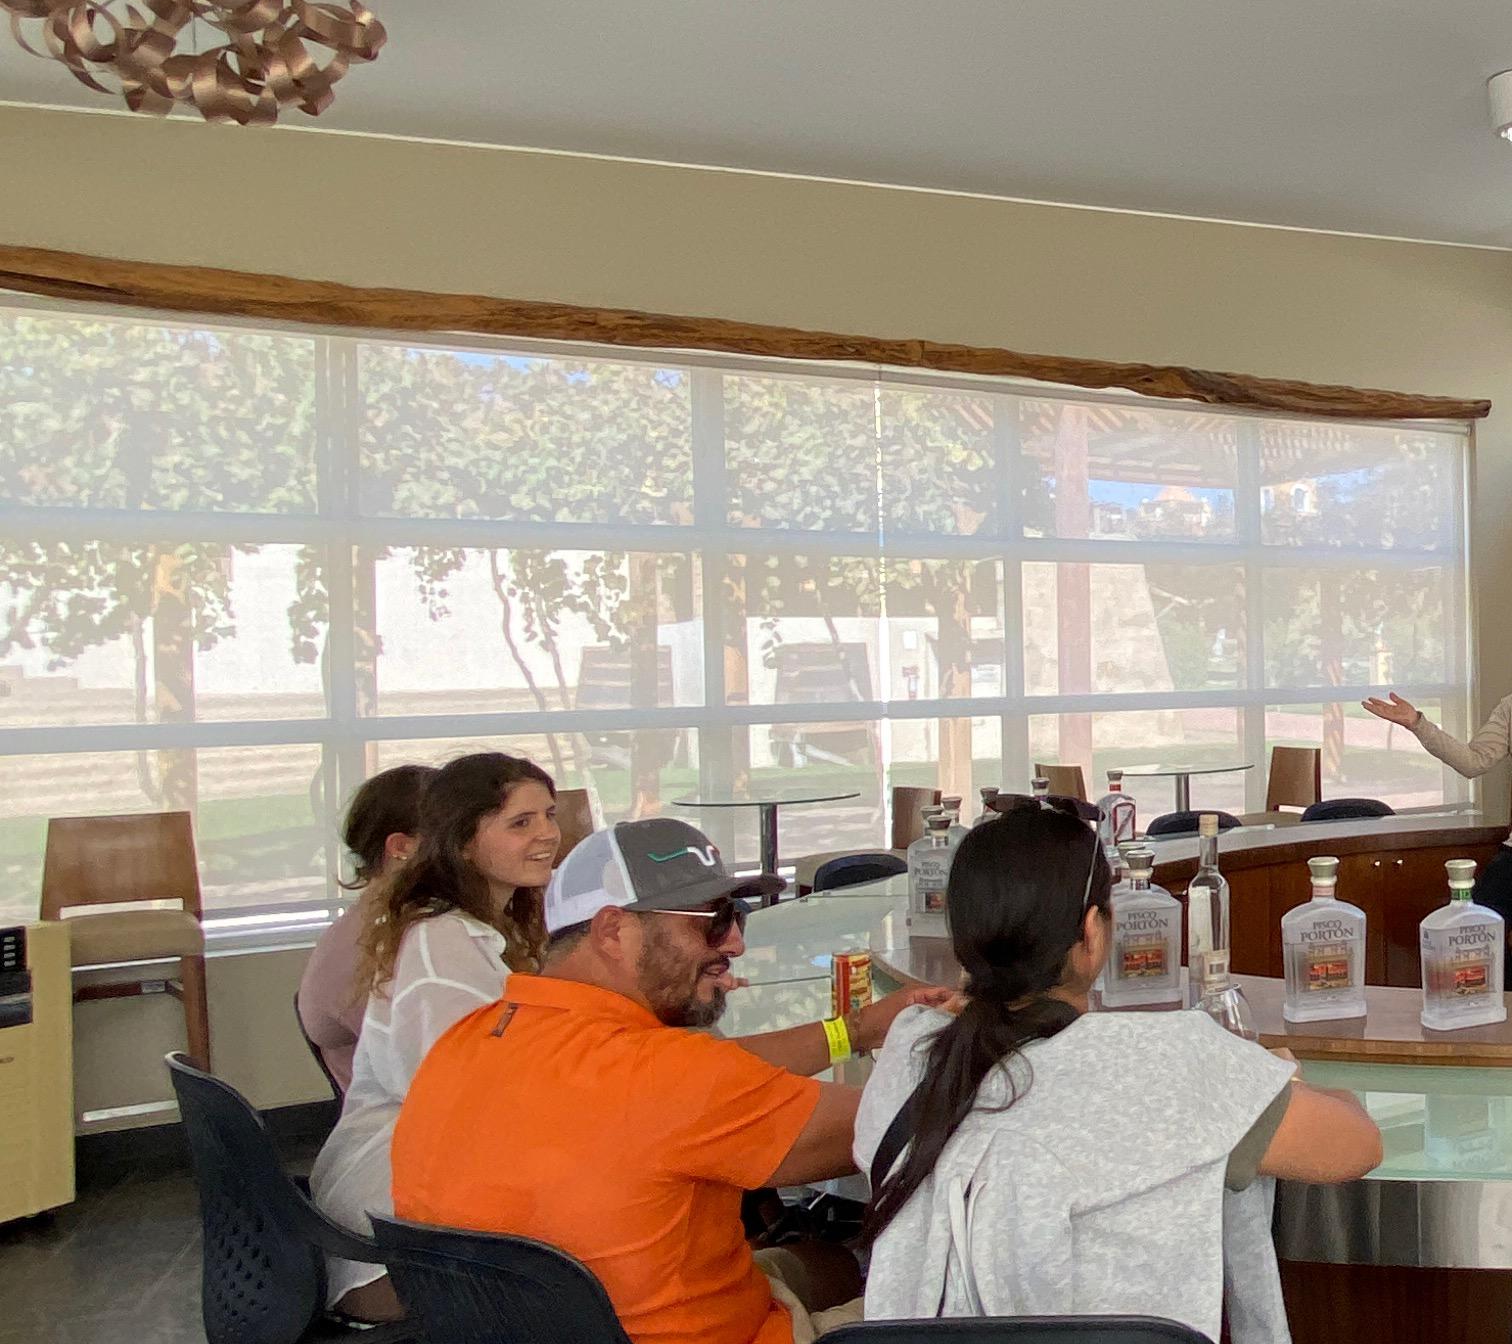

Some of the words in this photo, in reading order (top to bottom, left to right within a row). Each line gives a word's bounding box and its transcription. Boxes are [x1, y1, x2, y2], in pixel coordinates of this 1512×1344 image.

[1127, 911, 1157, 921] PISCO
[1312, 919, 1342, 930] PISCO
[1460, 924, 1487, 935] PISCO
